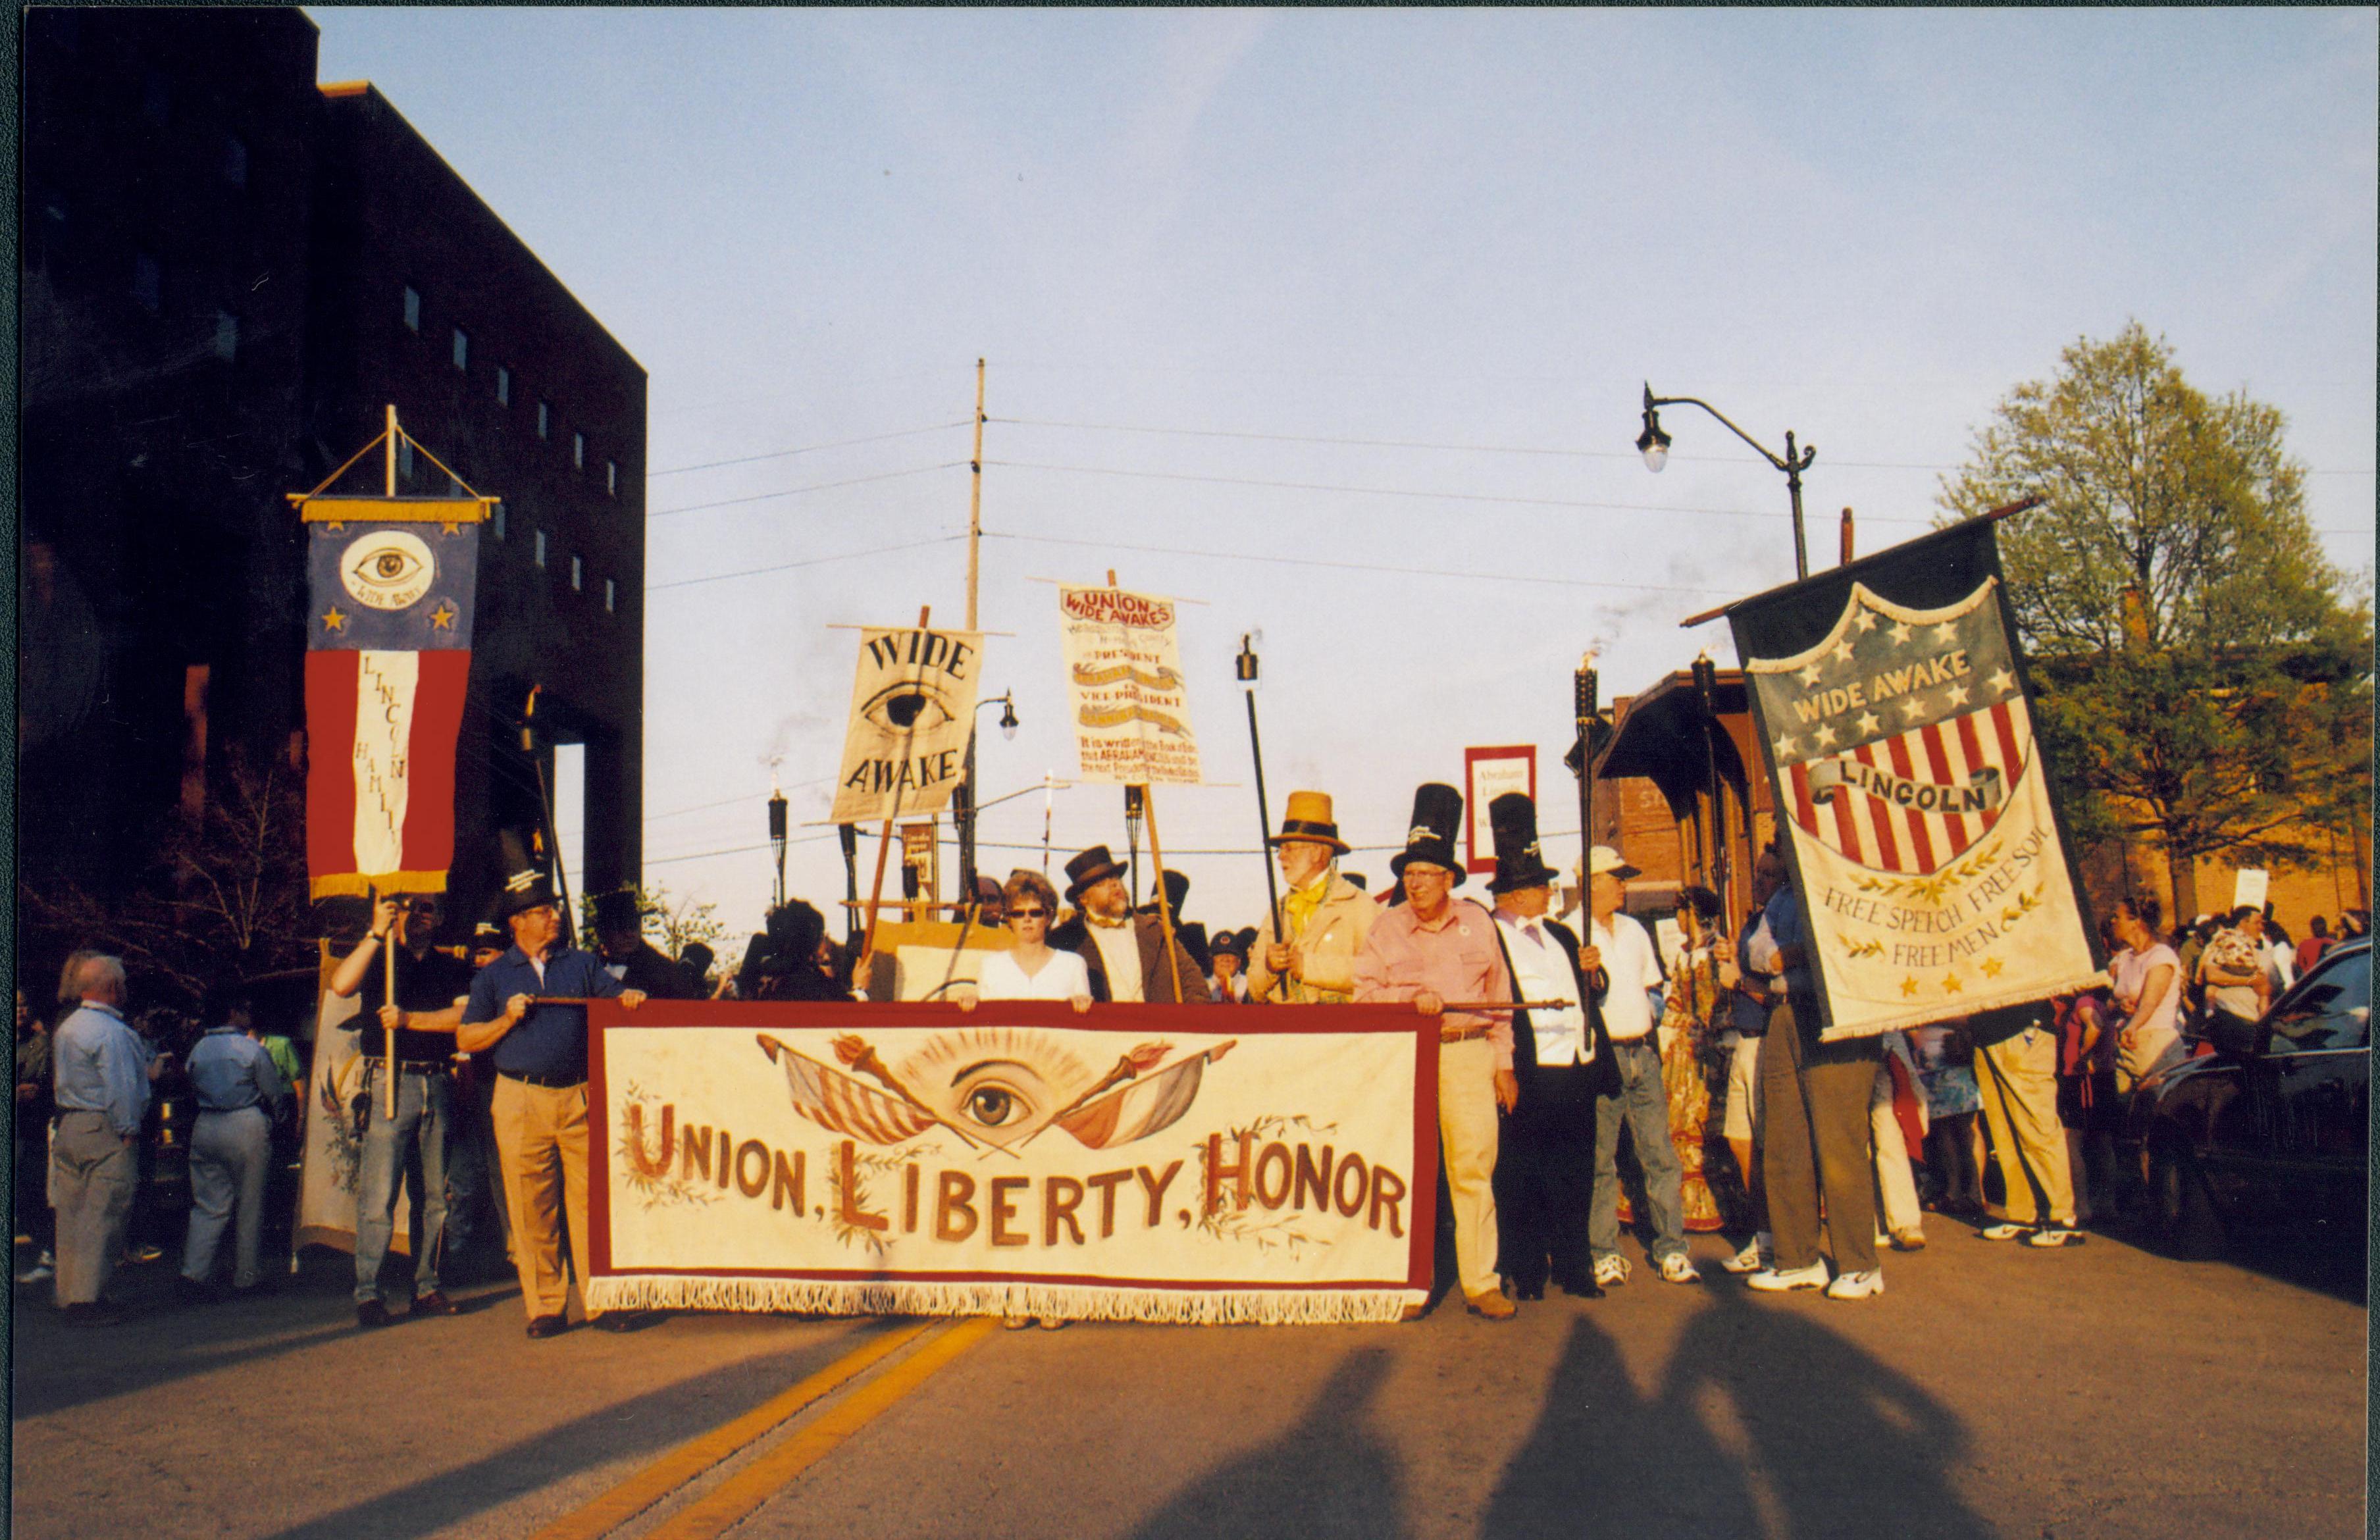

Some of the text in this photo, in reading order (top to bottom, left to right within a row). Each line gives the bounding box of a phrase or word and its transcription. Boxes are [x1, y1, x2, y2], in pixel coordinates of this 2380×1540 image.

[1066, 594, 1170, 625] WIDE AWAKES
[1084, 593, 1149, 613] UNION
[867, 630, 974, 680] WIDE
[1792, 649, 1972, 723] WIDE AWAKE
[844, 748, 958, 794] AWAKE
[1840, 760, 1986, 812] LINCOLN
[1825, 825, 2051, 933] FREE SPEECH FREE SOIL
[1893, 921, 2000, 967] FREE MEN
[630, 1104, 1407, 1247] UNION, LIBERTY, HONOR
